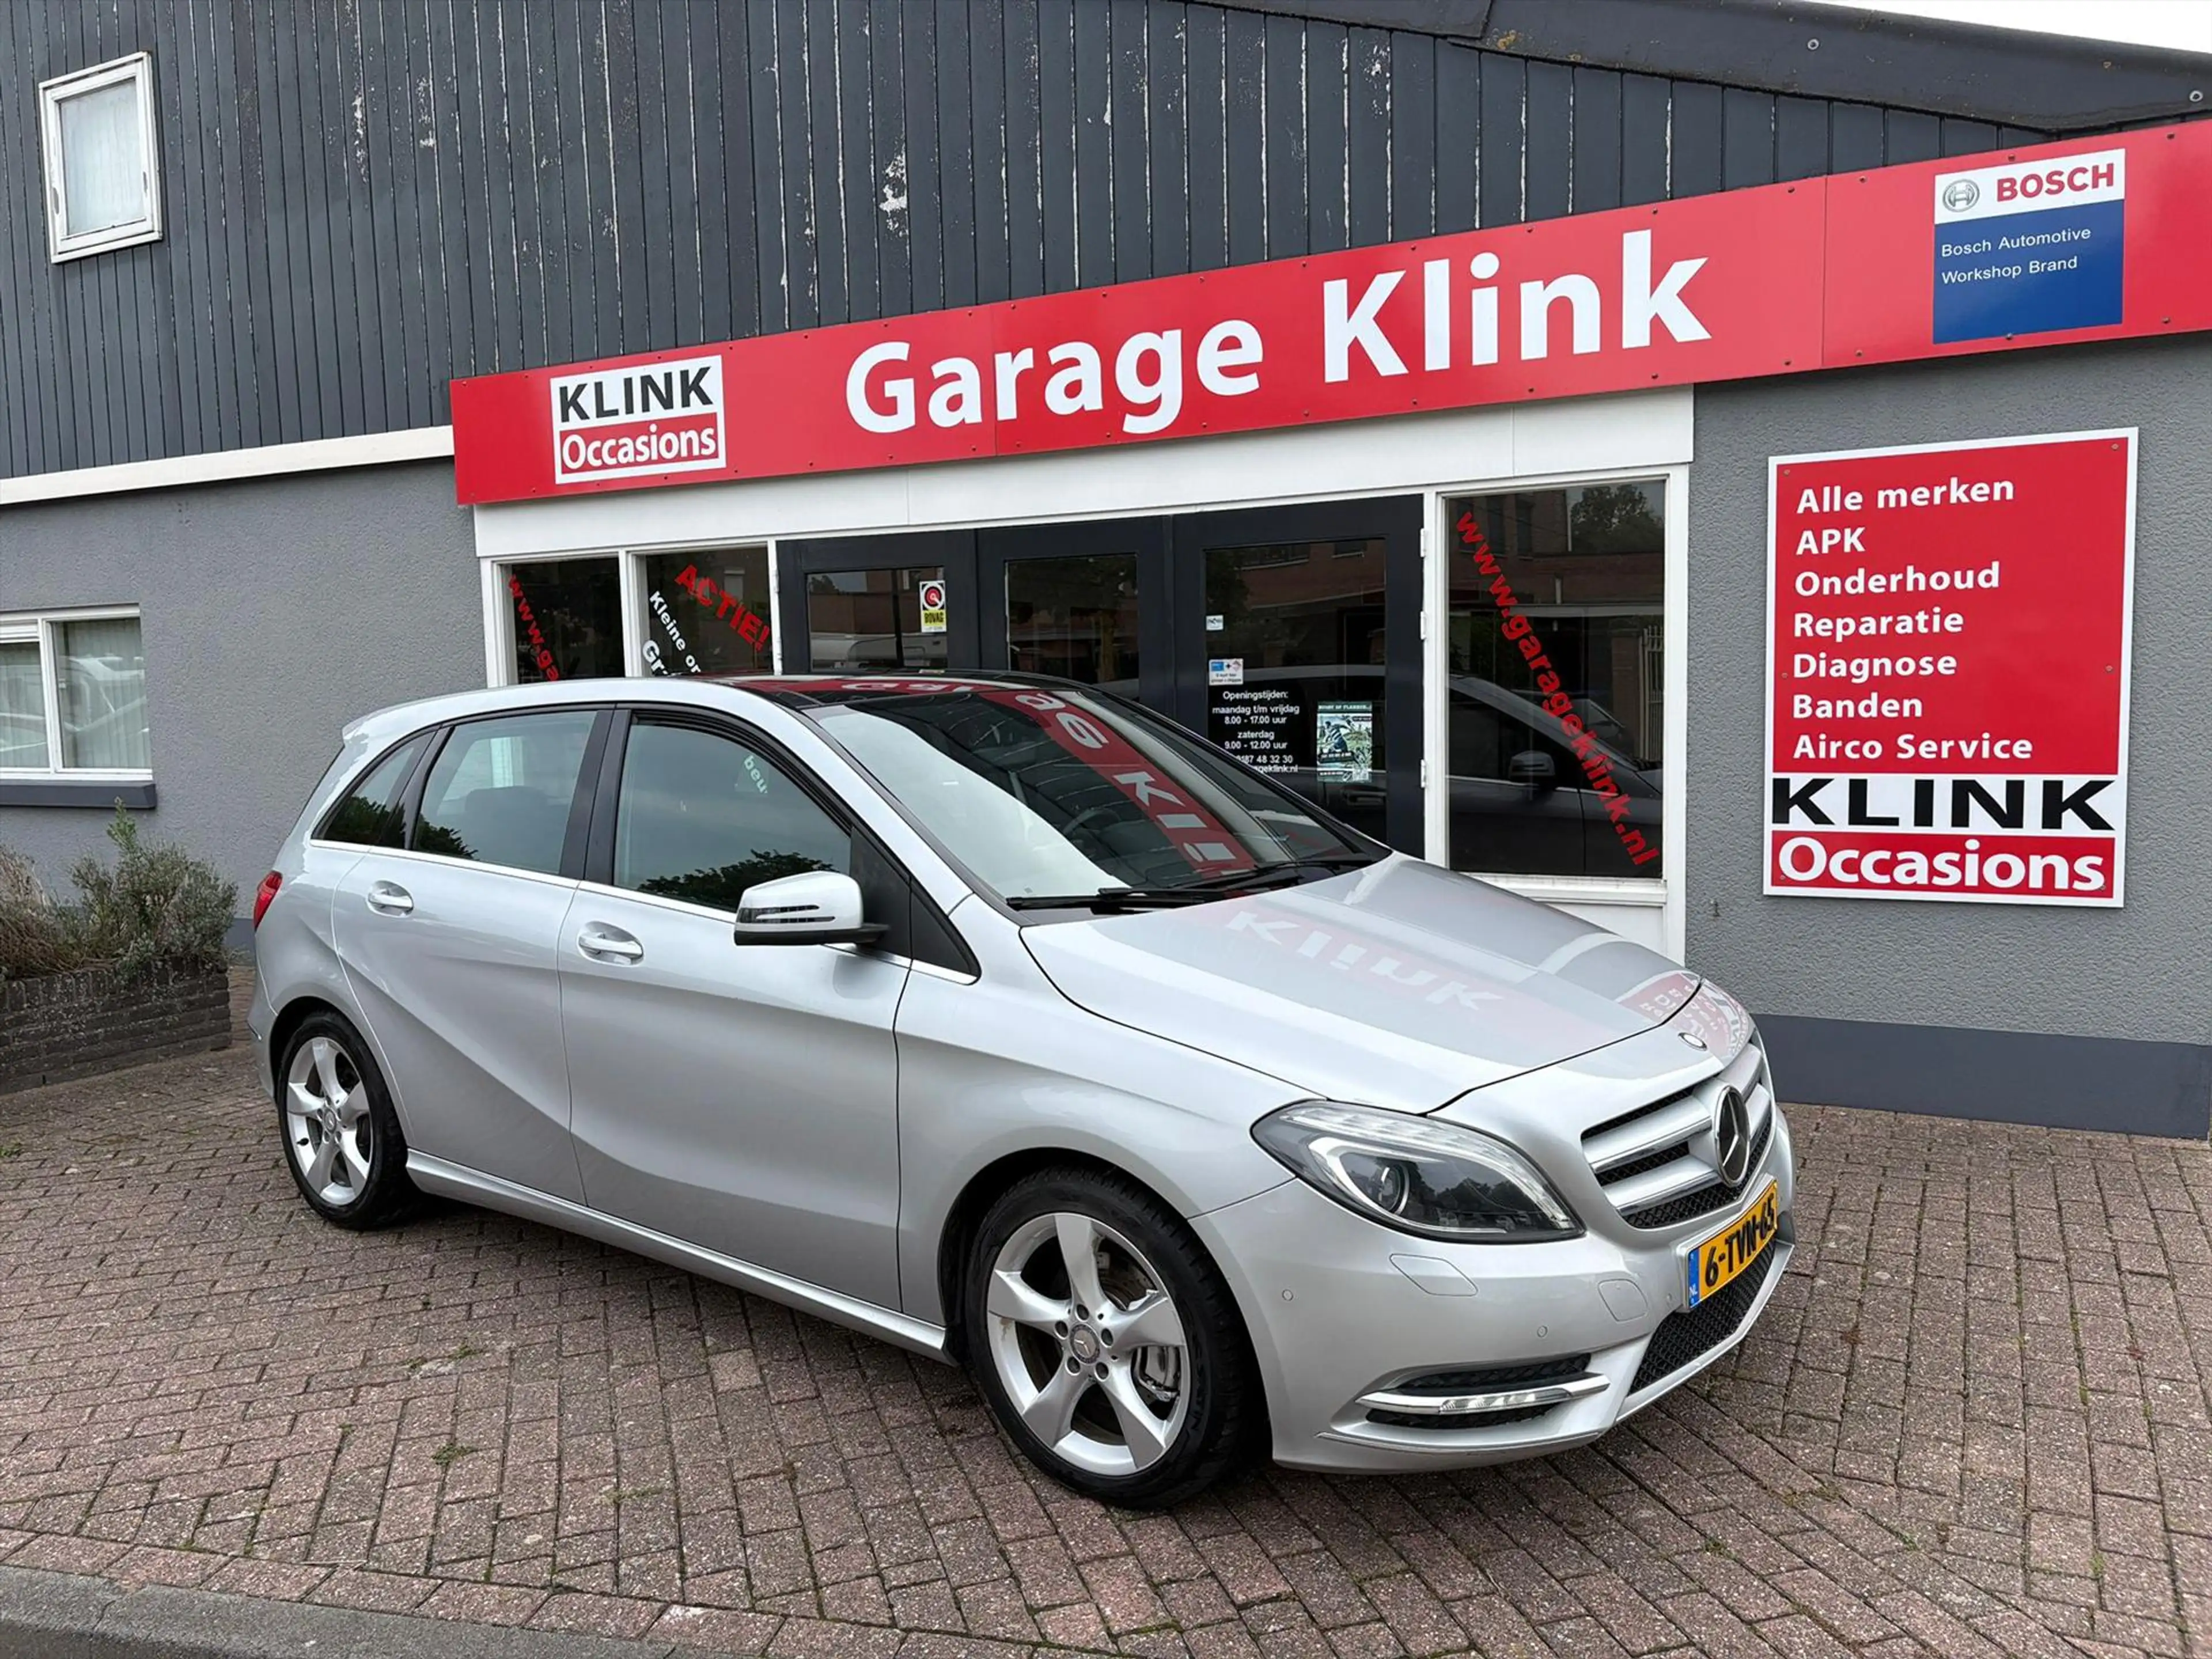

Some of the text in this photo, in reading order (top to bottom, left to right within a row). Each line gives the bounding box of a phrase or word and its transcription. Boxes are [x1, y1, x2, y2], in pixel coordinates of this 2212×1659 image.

[1997, 162, 2115, 202] BOSCH
[1942, 228, 2092, 257] Bosch Automotive
[1942, 256, 2077, 285] Workshop Brand
[846, 229, 1711, 434] Garage Klink
[559, 366, 714, 423] KLINK
[561, 425, 717, 470] Occasions
[1796, 477, 2015, 514] Alle merken
[1796, 527, 1866, 555] APK
[1795, 562, 2001, 596] Onderhoud
[649, 591, 686, 652] Kleine
[674, 564, 771, 652] ACTIE!
[1793, 607, 1964, 642] Reparatie
[1793, 652, 1957, 684] Diagnose
[1222, 690, 1289, 701] Openingstijden:
[1456, 512, 1659, 865] www.garageklink.nl
[1793, 692, 1923, 718] Banden
[1212, 704, 1300, 715] maandag t/m vrijdag
[1224, 716, 1241, 725] 8.00
[1250, 715, 1270, 724] 17.00
[1224, 741, 1241, 749] 9.00
[1249, 741, 1271, 749] 12.00
[1237, 730, 1275, 740] zaterdag
[1793, 732, 2033, 760] Airco Service
[1256, 755, 1268, 764] 48
[1270, 755, 1280, 764] 32
[1282, 755, 1293, 764] 30
[1771, 777, 2115, 831] KLINK
[1778, 836, 2105, 892] Occasions
